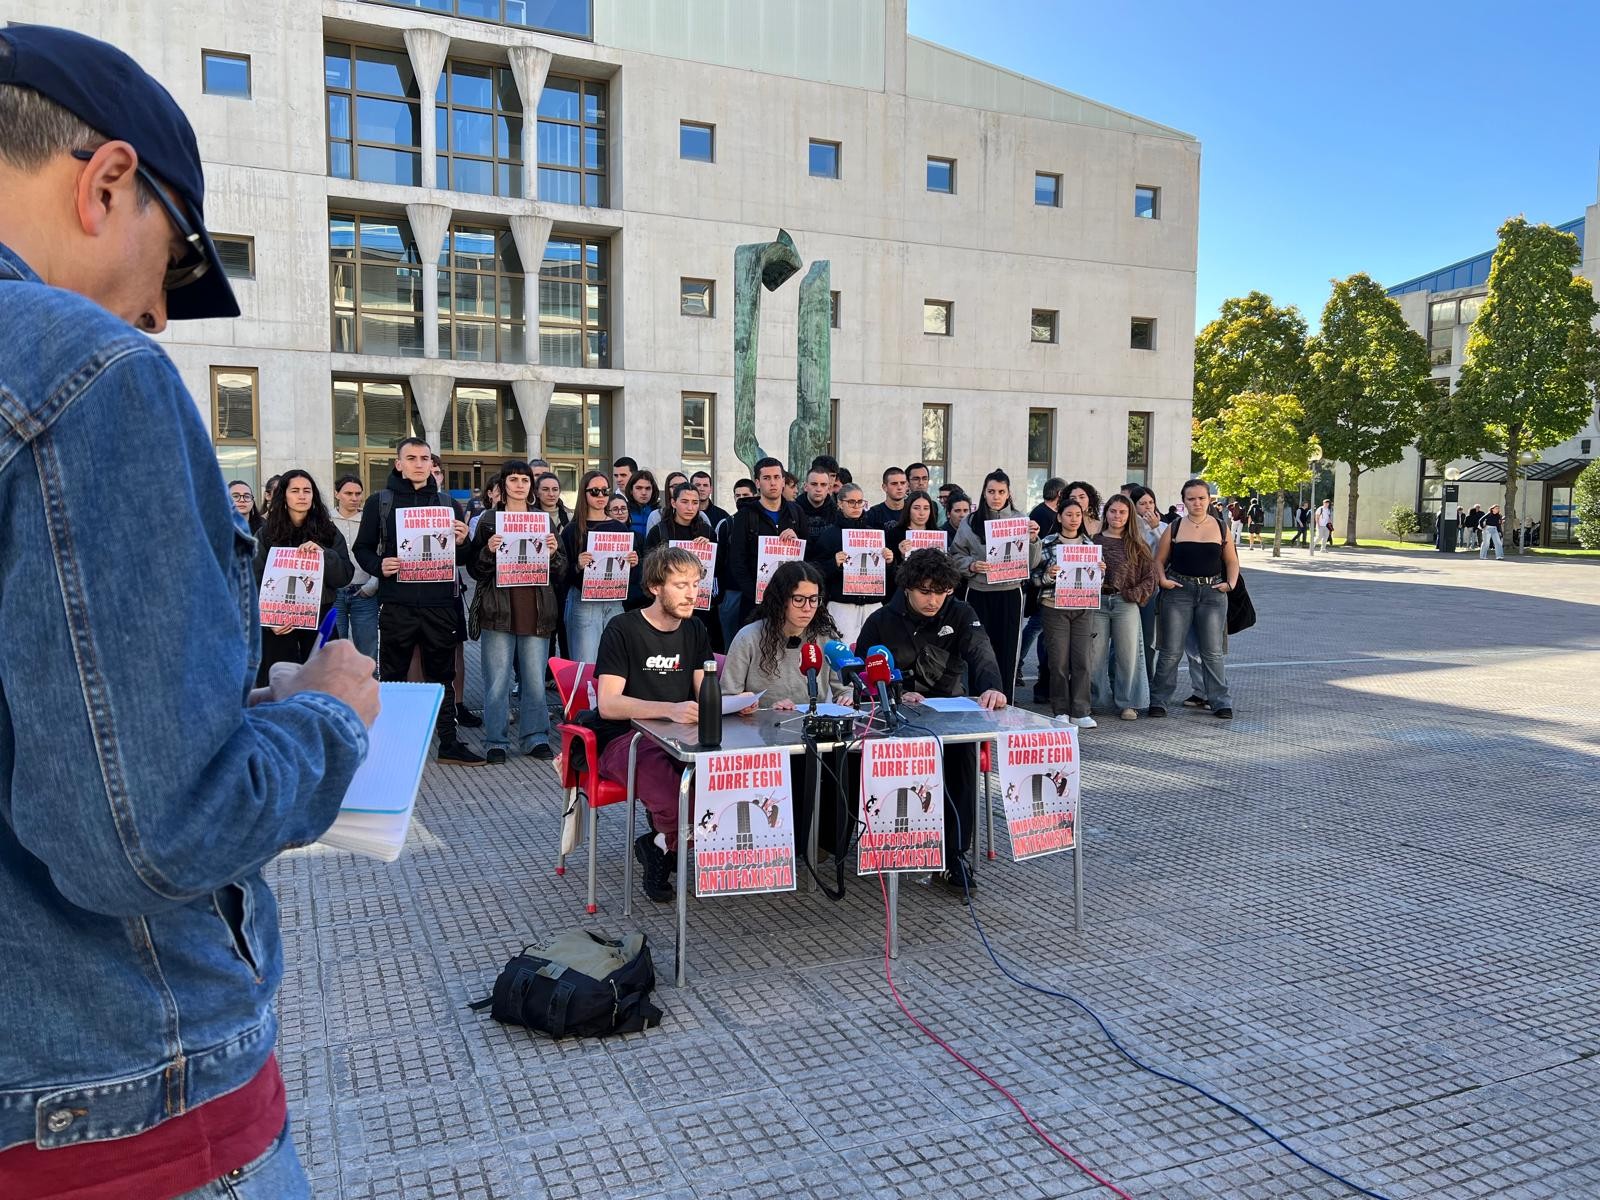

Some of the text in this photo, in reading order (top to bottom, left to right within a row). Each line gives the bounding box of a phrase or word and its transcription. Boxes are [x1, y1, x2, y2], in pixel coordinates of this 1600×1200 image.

[404, 509, 450, 518] FAXISMOARI
[504, 514, 545, 522] FAXISMOARI
[405, 519, 450, 528] AURRE EGIN
[504, 524, 545, 532] AURRE EGIN
[991, 519, 1028, 529] FAXISMOARI
[849, 531, 882, 539] FAXISMOARI
[912, 532, 944, 540] FAXISMOARI
[992, 527, 1028, 538] AURRE EGIN
[595, 534, 631, 542] FAXISMOARI
[594, 543, 615, 551] AURRE
[849, 540, 882, 548] AURRE EGIN
[765, 546, 801, 556] AURRE EGIN
[1062, 546, 1098, 554] FAXISMOARI
[1063, 554, 1098, 563] AURRE EGIN
[273, 558, 320, 571] AURRE EGIN
[1008, 731, 1071, 748] FAXISMOARI
[872, 741, 935, 759] FAXISMOARI
[1008, 747, 1072, 766] AURRE EGIN
[708, 753, 782, 773] FAXISMOARI
[872, 759, 935, 777] AURRE EGIN
[708, 770, 782, 791] AURRE EGIN
[861, 831, 940, 848] UNIBERTSITATEA
[698, 847, 791, 867] UNIBERTSITATEA
[860, 848, 942, 870] ANTIFAXISTA
[698, 866, 793, 891] ANTIFAXISTA
